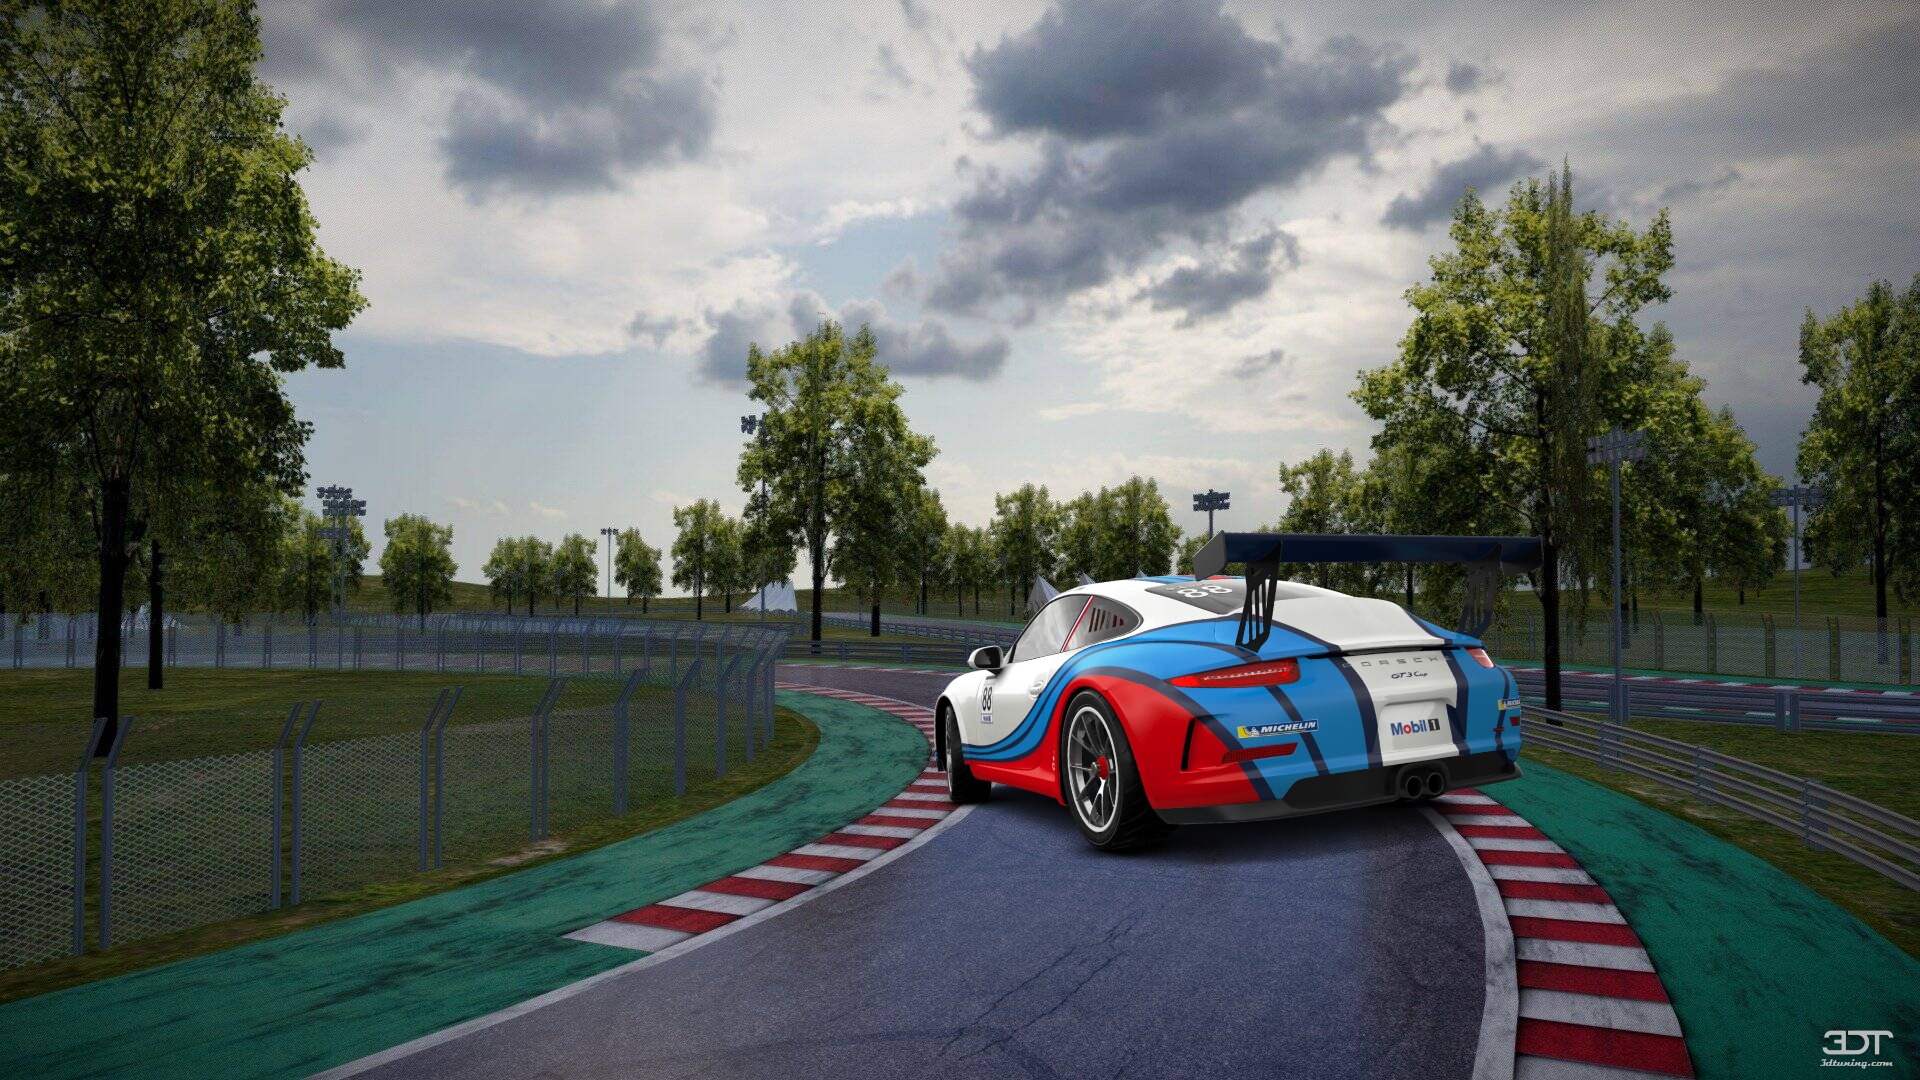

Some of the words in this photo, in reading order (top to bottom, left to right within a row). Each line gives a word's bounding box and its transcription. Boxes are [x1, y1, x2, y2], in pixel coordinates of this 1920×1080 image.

[1177, 585, 1233, 598] 88
[982, 686, 993, 711] 88
[1260, 721, 1316, 734] MICHELIN
[1390, 719, 1427, 736] Mobil
[1429, 718, 1439, 731] 1
